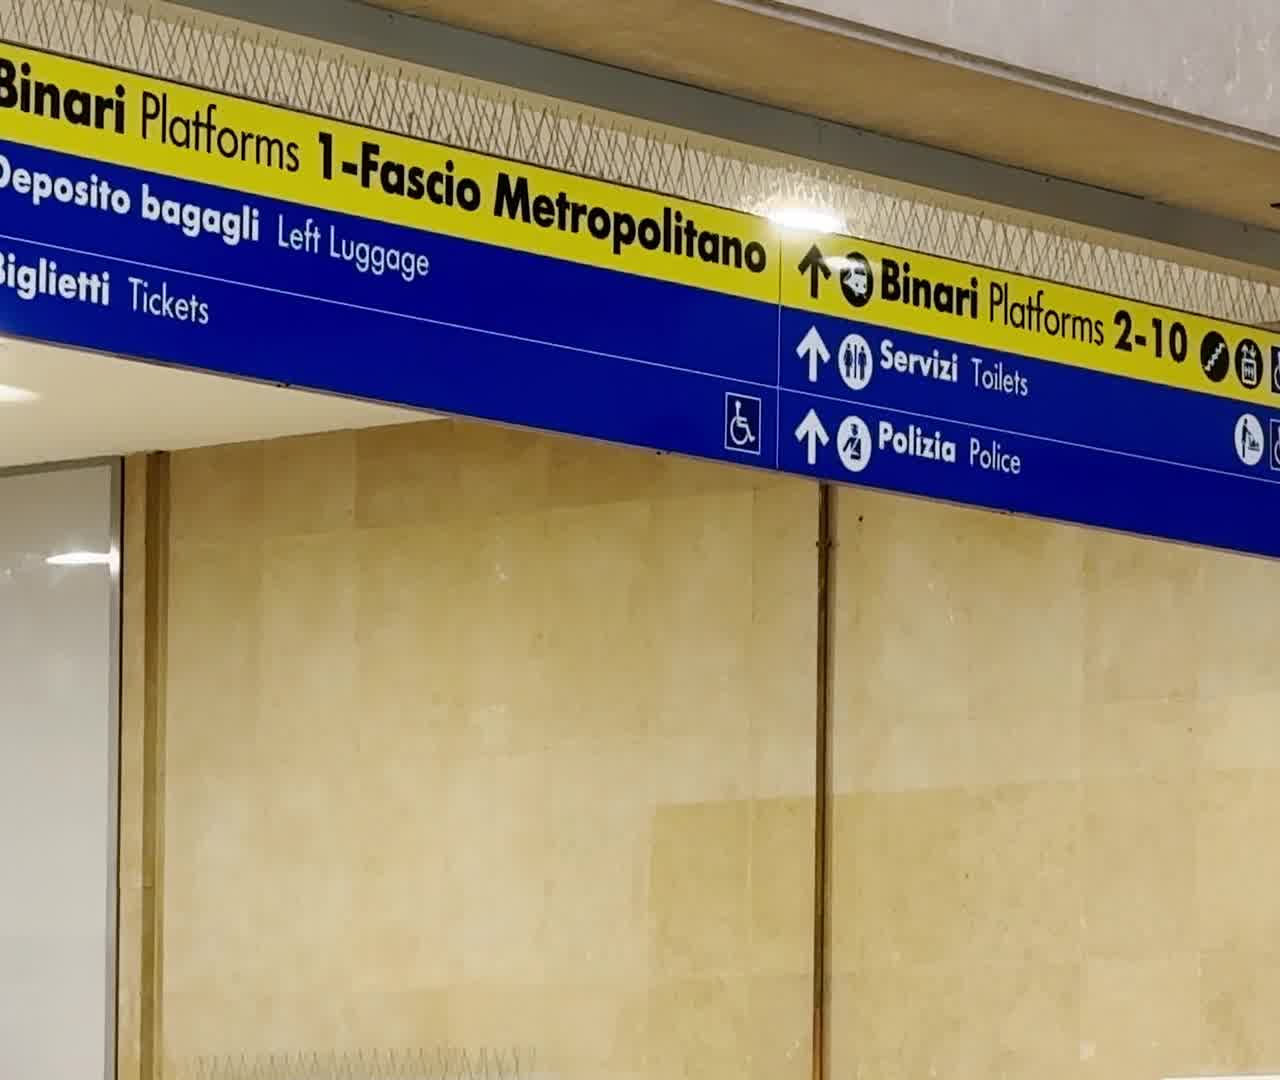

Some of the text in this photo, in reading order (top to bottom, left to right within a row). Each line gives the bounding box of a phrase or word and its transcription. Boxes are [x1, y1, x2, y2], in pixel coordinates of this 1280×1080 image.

[142, 92, 300, 172] Platforms
[319, 132, 481, 211] 1-Fascio
[493, 172, 767, 274] Metropolitano
[141, 184, 259, 246] bagagli
[278, 216, 321, 255] Left
[330, 225, 430, 282] Luggage
[128, 277, 209, 325] Tickets
[881, 258, 1188, 363] Binari Platforms 2-10
[880, 341, 1028, 397] Servizi Toilets
[879, 421, 1022, 475] Polizia Police
